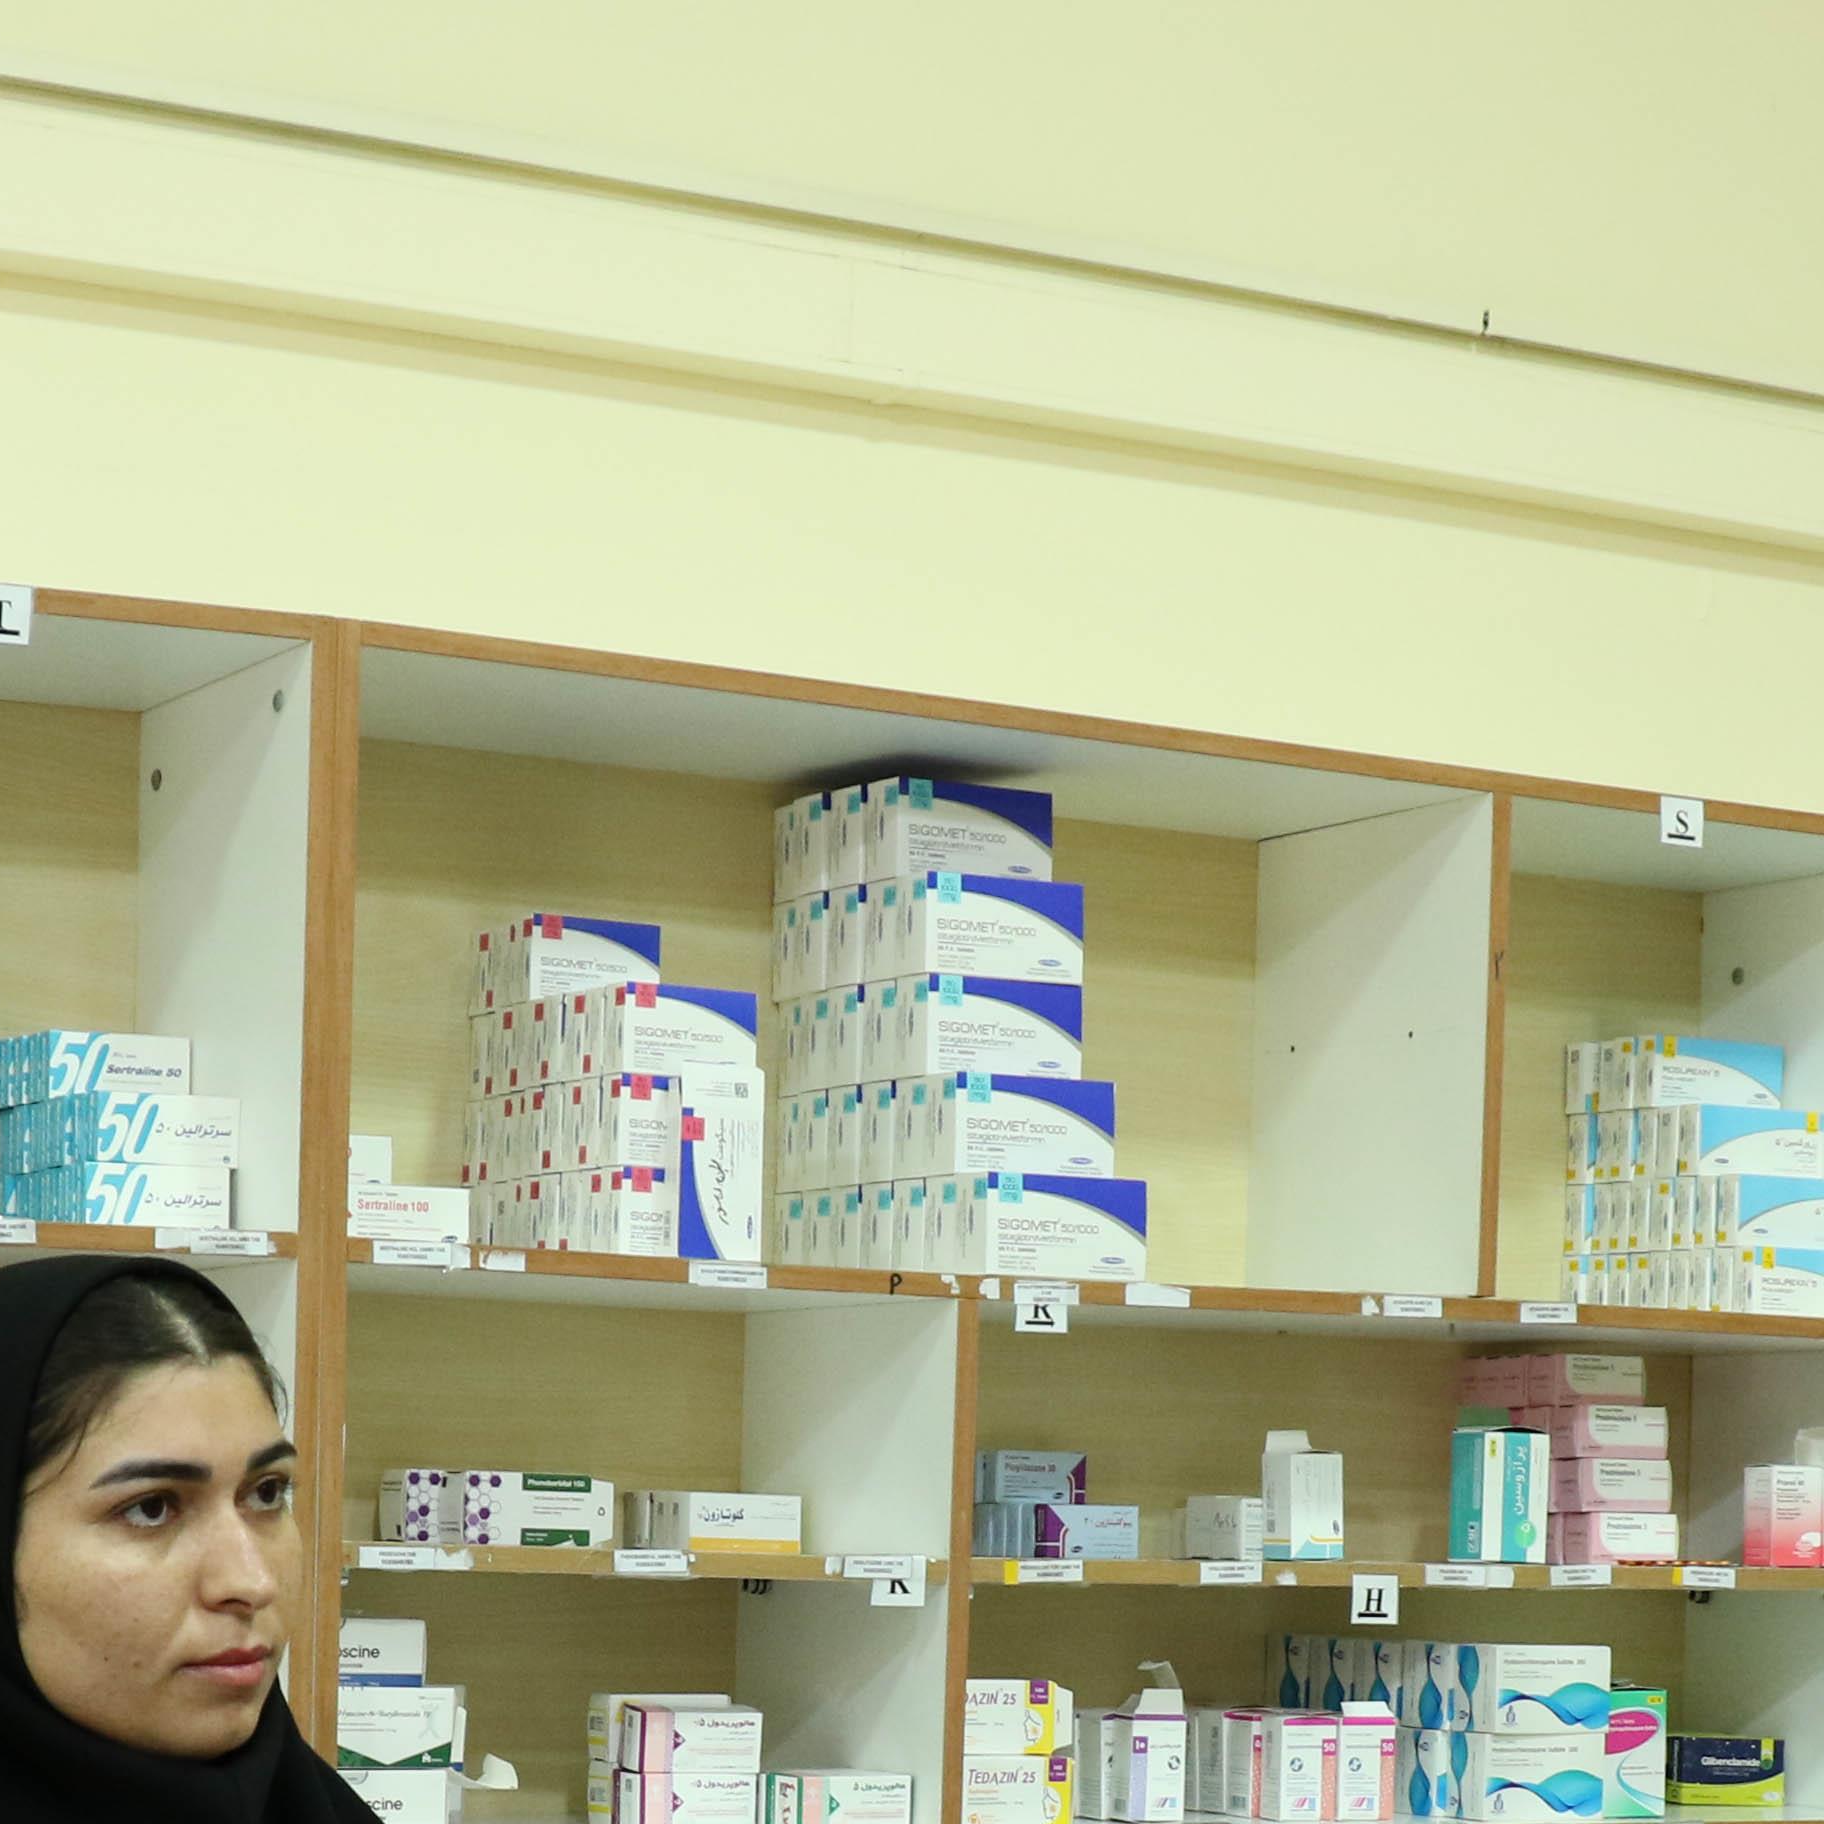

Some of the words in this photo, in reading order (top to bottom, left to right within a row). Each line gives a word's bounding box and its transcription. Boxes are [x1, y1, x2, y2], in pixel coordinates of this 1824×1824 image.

[1675, 810, 1689, 834] S
[908, 823, 966, 839] SIGOMET
[936, 918, 995, 934] SIGOMET
[539, 956, 593, 971] SIGOMET
[633, 1024, 687, 1039] SIGOMET
[937, 1020, 996, 1036] SIGOMET
[48, 1031, 112, 1098] 50
[105, 1063, 163, 1077] Sertraline
[96, 1092, 160, 1163] 50
[966, 1117, 1028, 1134] SIGOMET
[84, 1162, 150, 1225] 50
[357, 1199, 409, 1213] Sertraline
[411, 1201, 430, 1213] 100
[997, 1218, 1057, 1232] SIGOMET
[1363, 1587, 1384, 1613] H
[1002, 1693, 1017, 1706] 25
[1323, 1741, 1336, 1752] 50
[1382, 1741, 1395, 1753] 50
[967, 1768, 1018, 1786] TEDAZIN
[1022, 1771, 1037, 1785] 25
